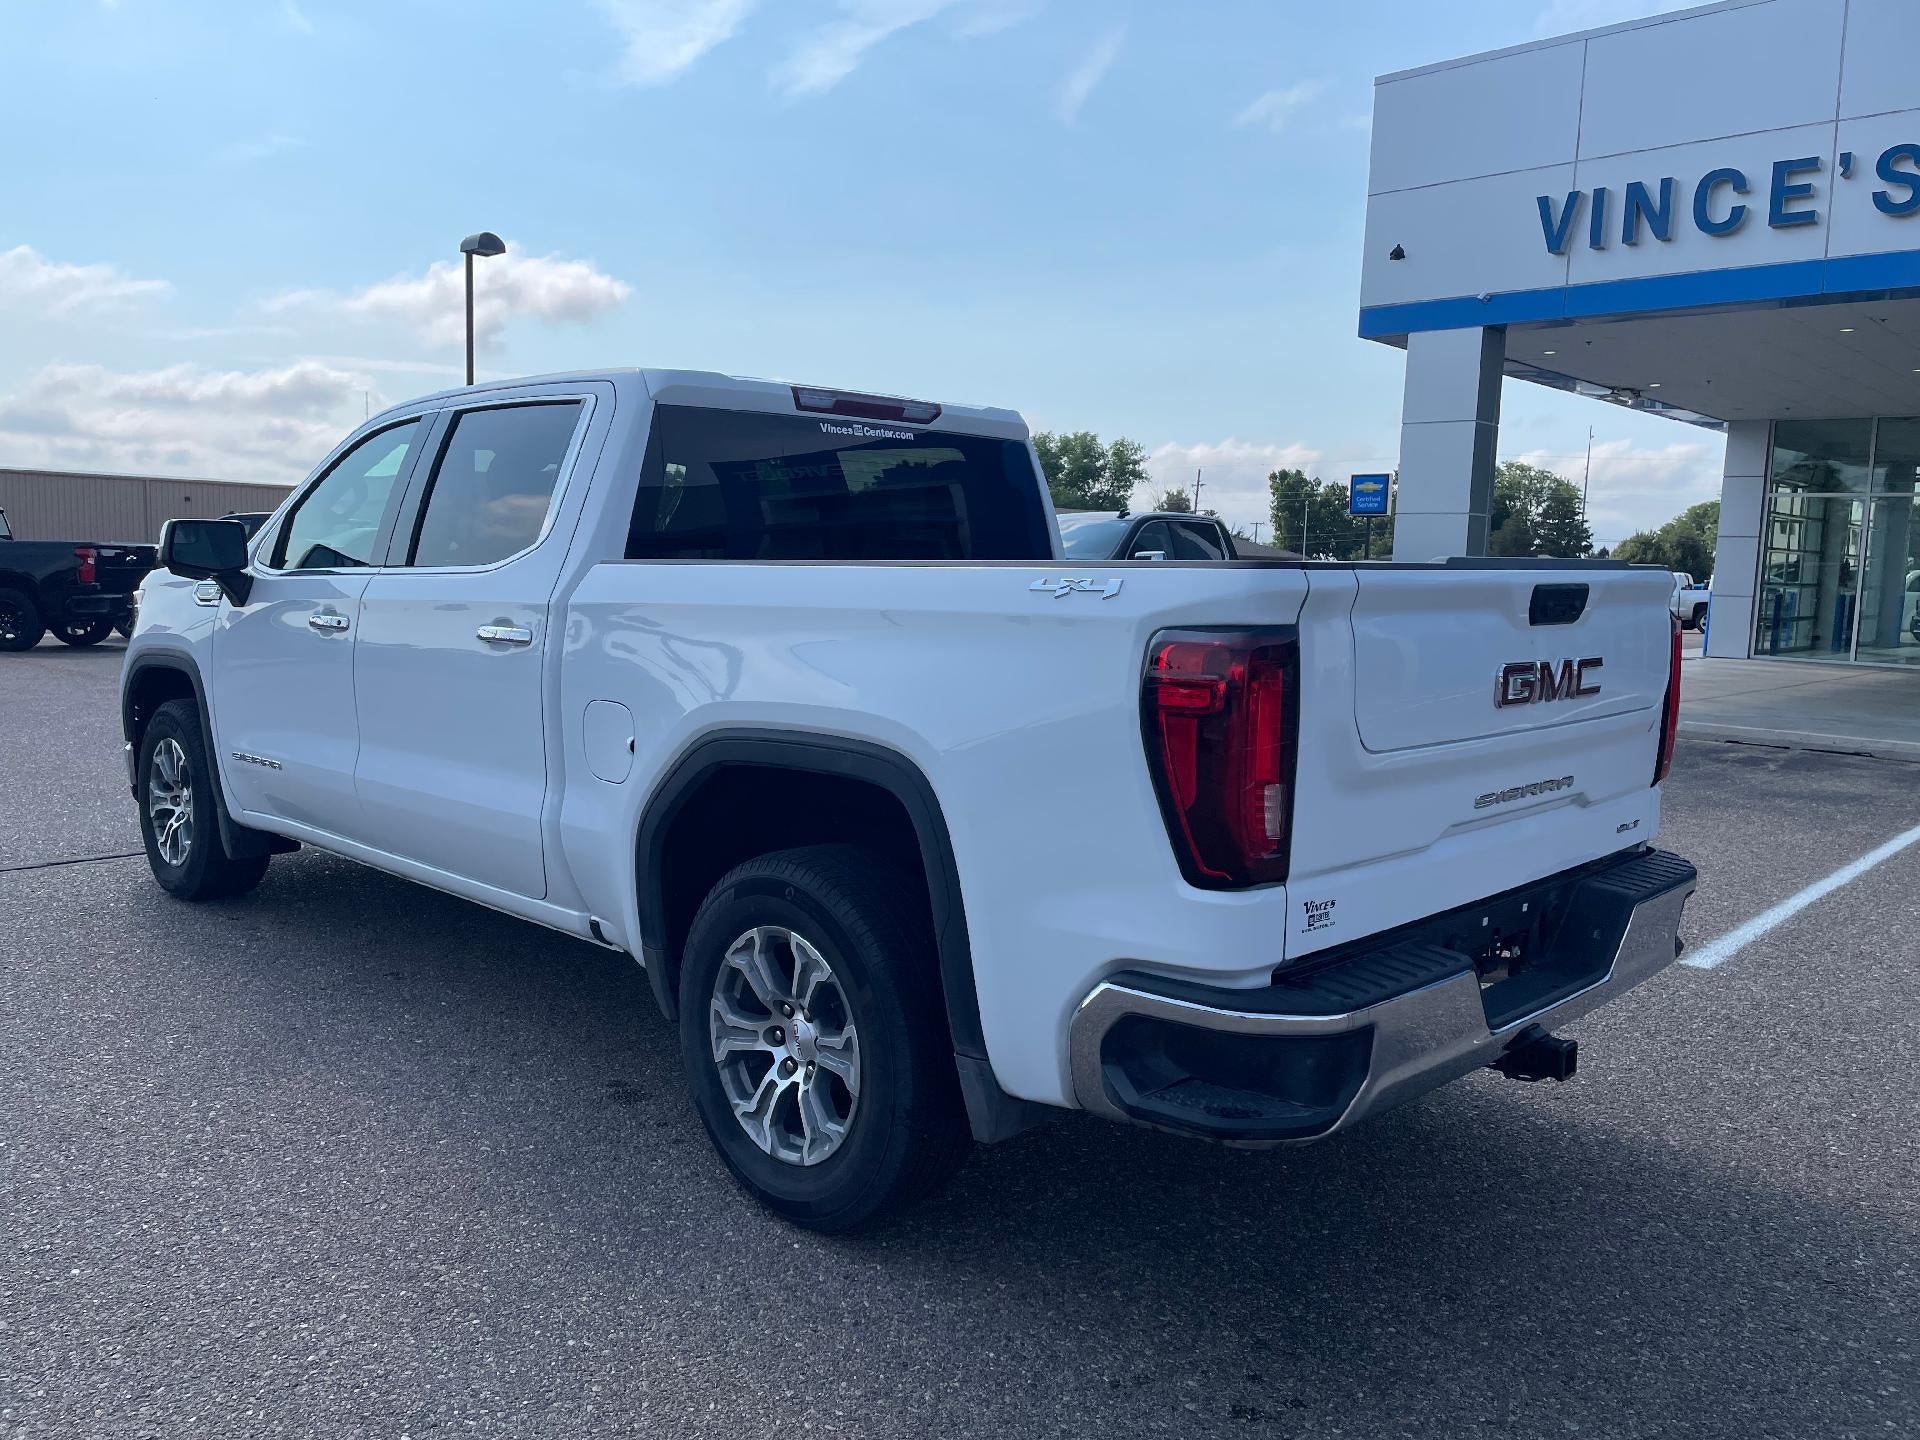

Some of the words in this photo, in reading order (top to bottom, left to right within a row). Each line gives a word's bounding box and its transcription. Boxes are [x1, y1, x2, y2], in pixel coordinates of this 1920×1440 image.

[1536, 143, 1920, 256] VINCE'S
[1494, 656, 1604, 709] GMC
[1473, 775, 1575, 809] SIERRA
